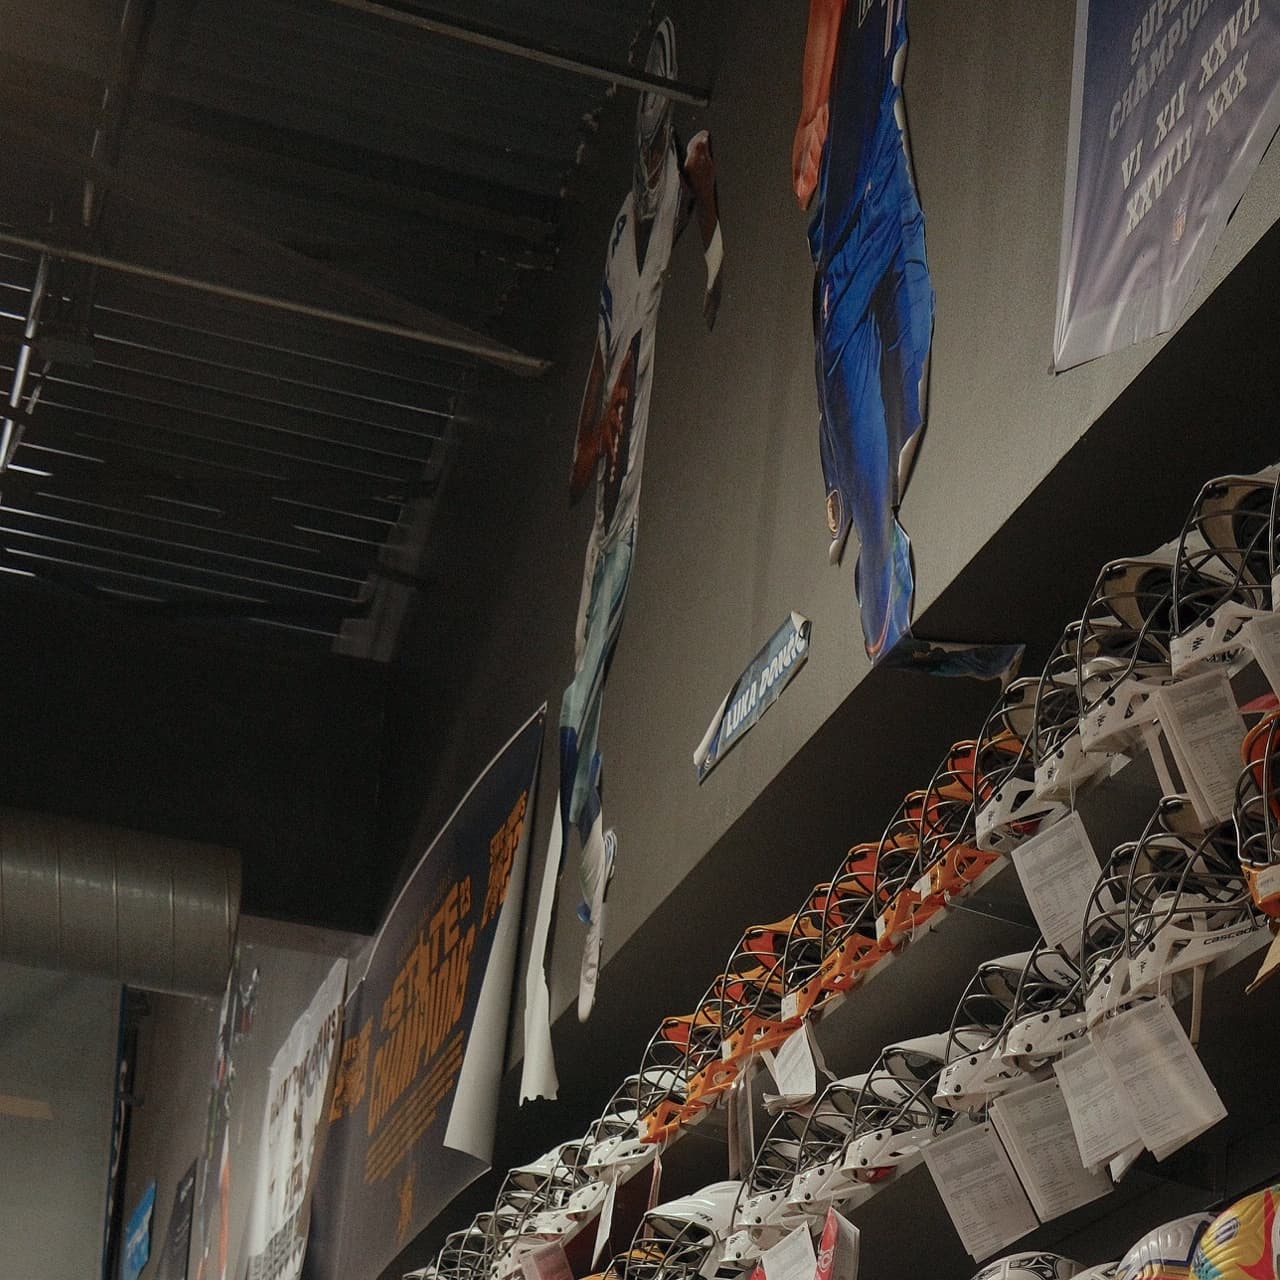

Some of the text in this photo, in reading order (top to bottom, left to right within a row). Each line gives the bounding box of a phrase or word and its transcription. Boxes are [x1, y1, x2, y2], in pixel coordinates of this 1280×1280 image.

[1121, 138, 1144, 190] VI
[1152, 80, 1187, 152] XII
[1206, 50, 1250, 137] XXX
[726, 681, 757, 738] LUKA
